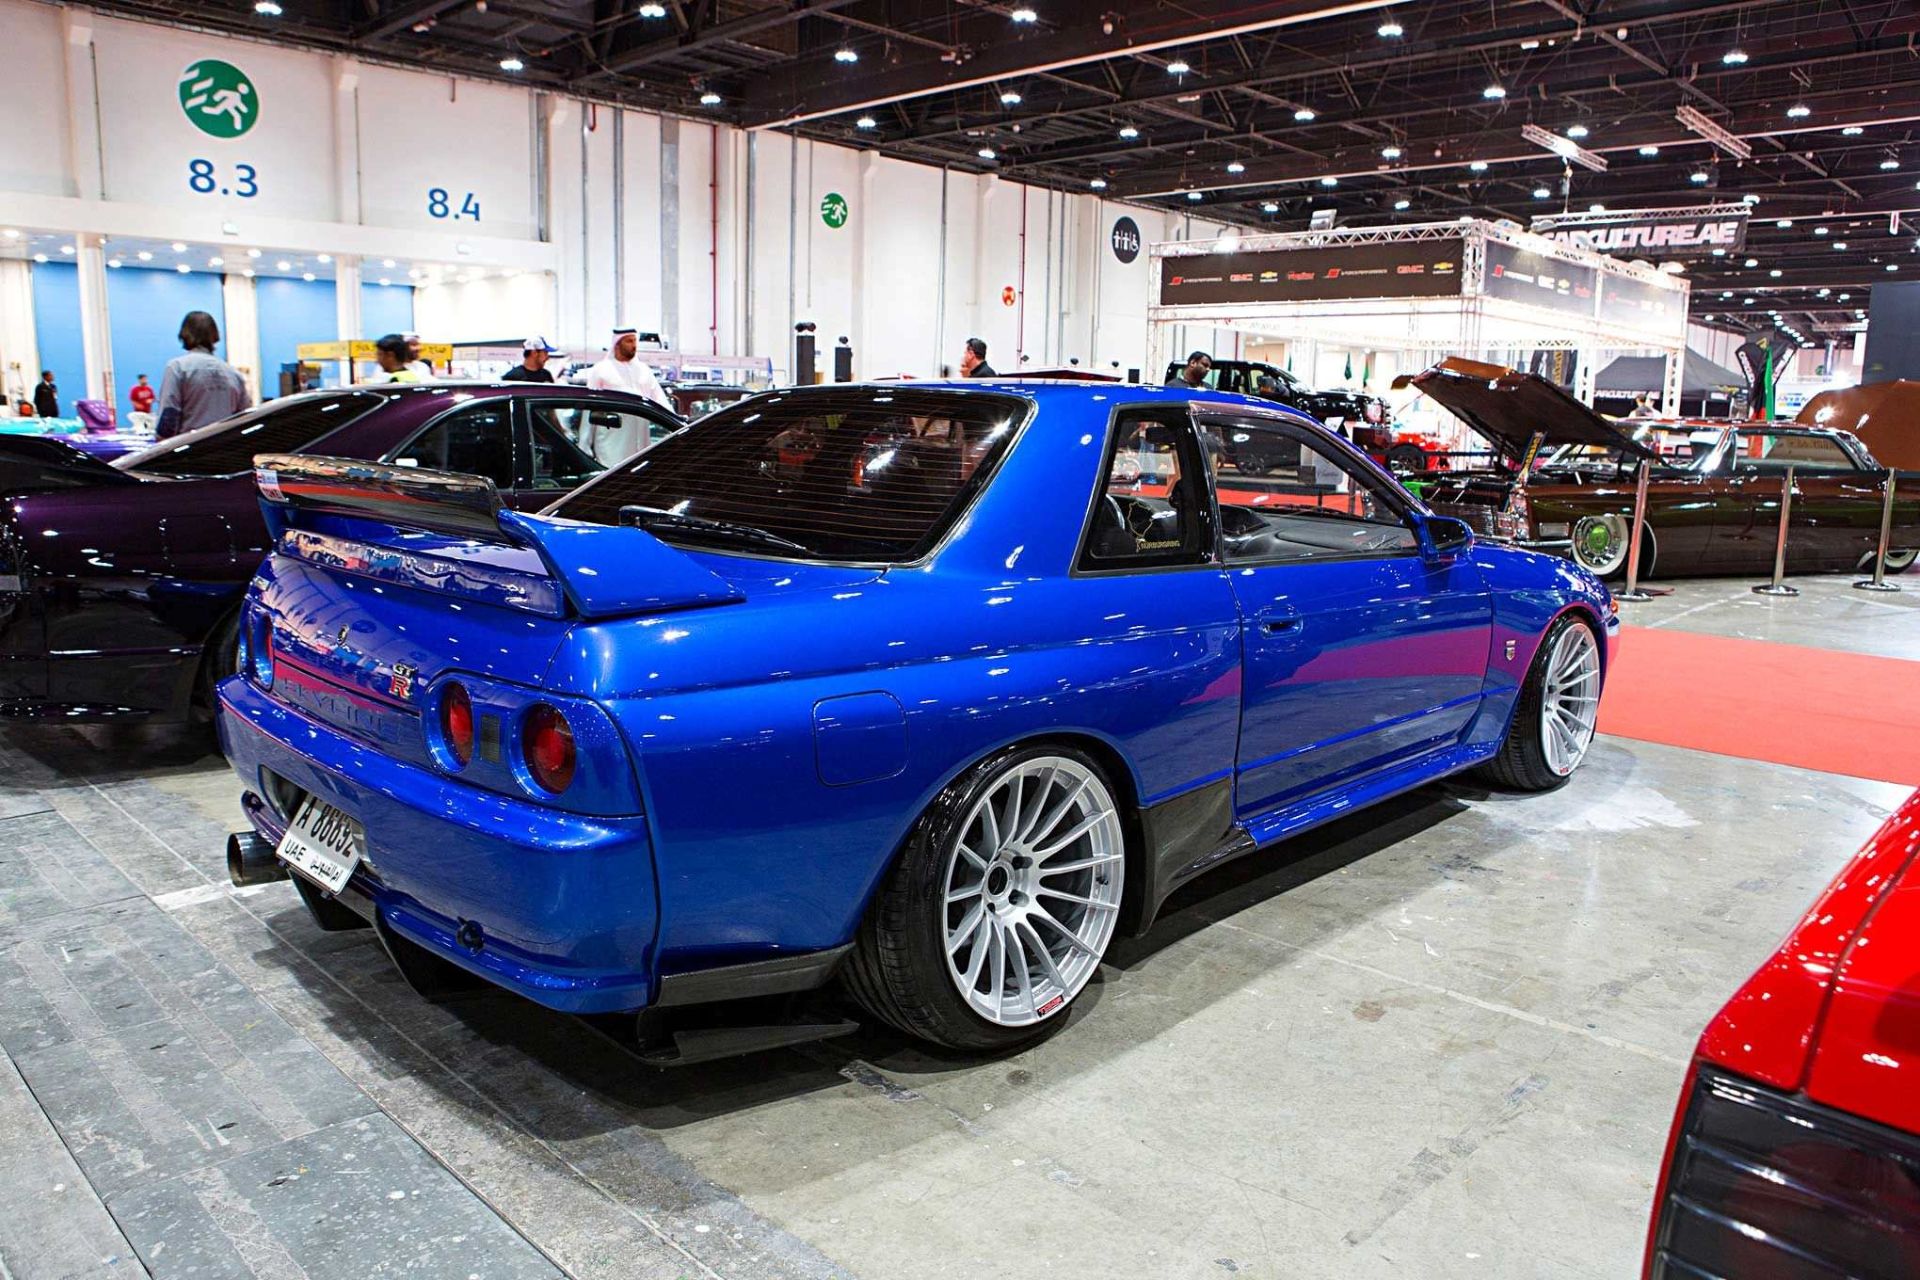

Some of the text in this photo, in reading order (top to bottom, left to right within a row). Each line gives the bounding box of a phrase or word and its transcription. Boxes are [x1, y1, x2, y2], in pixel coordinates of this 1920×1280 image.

[188, 159, 259, 198] 8.3
[427, 187, 481, 222] 8.4
[1397, 265, 1424, 274] GMC
[392, 663, 416, 676] GT
[389, 673, 411, 699] R
[296, 796, 318, 829] A
[284, 838, 307, 861] UAE
